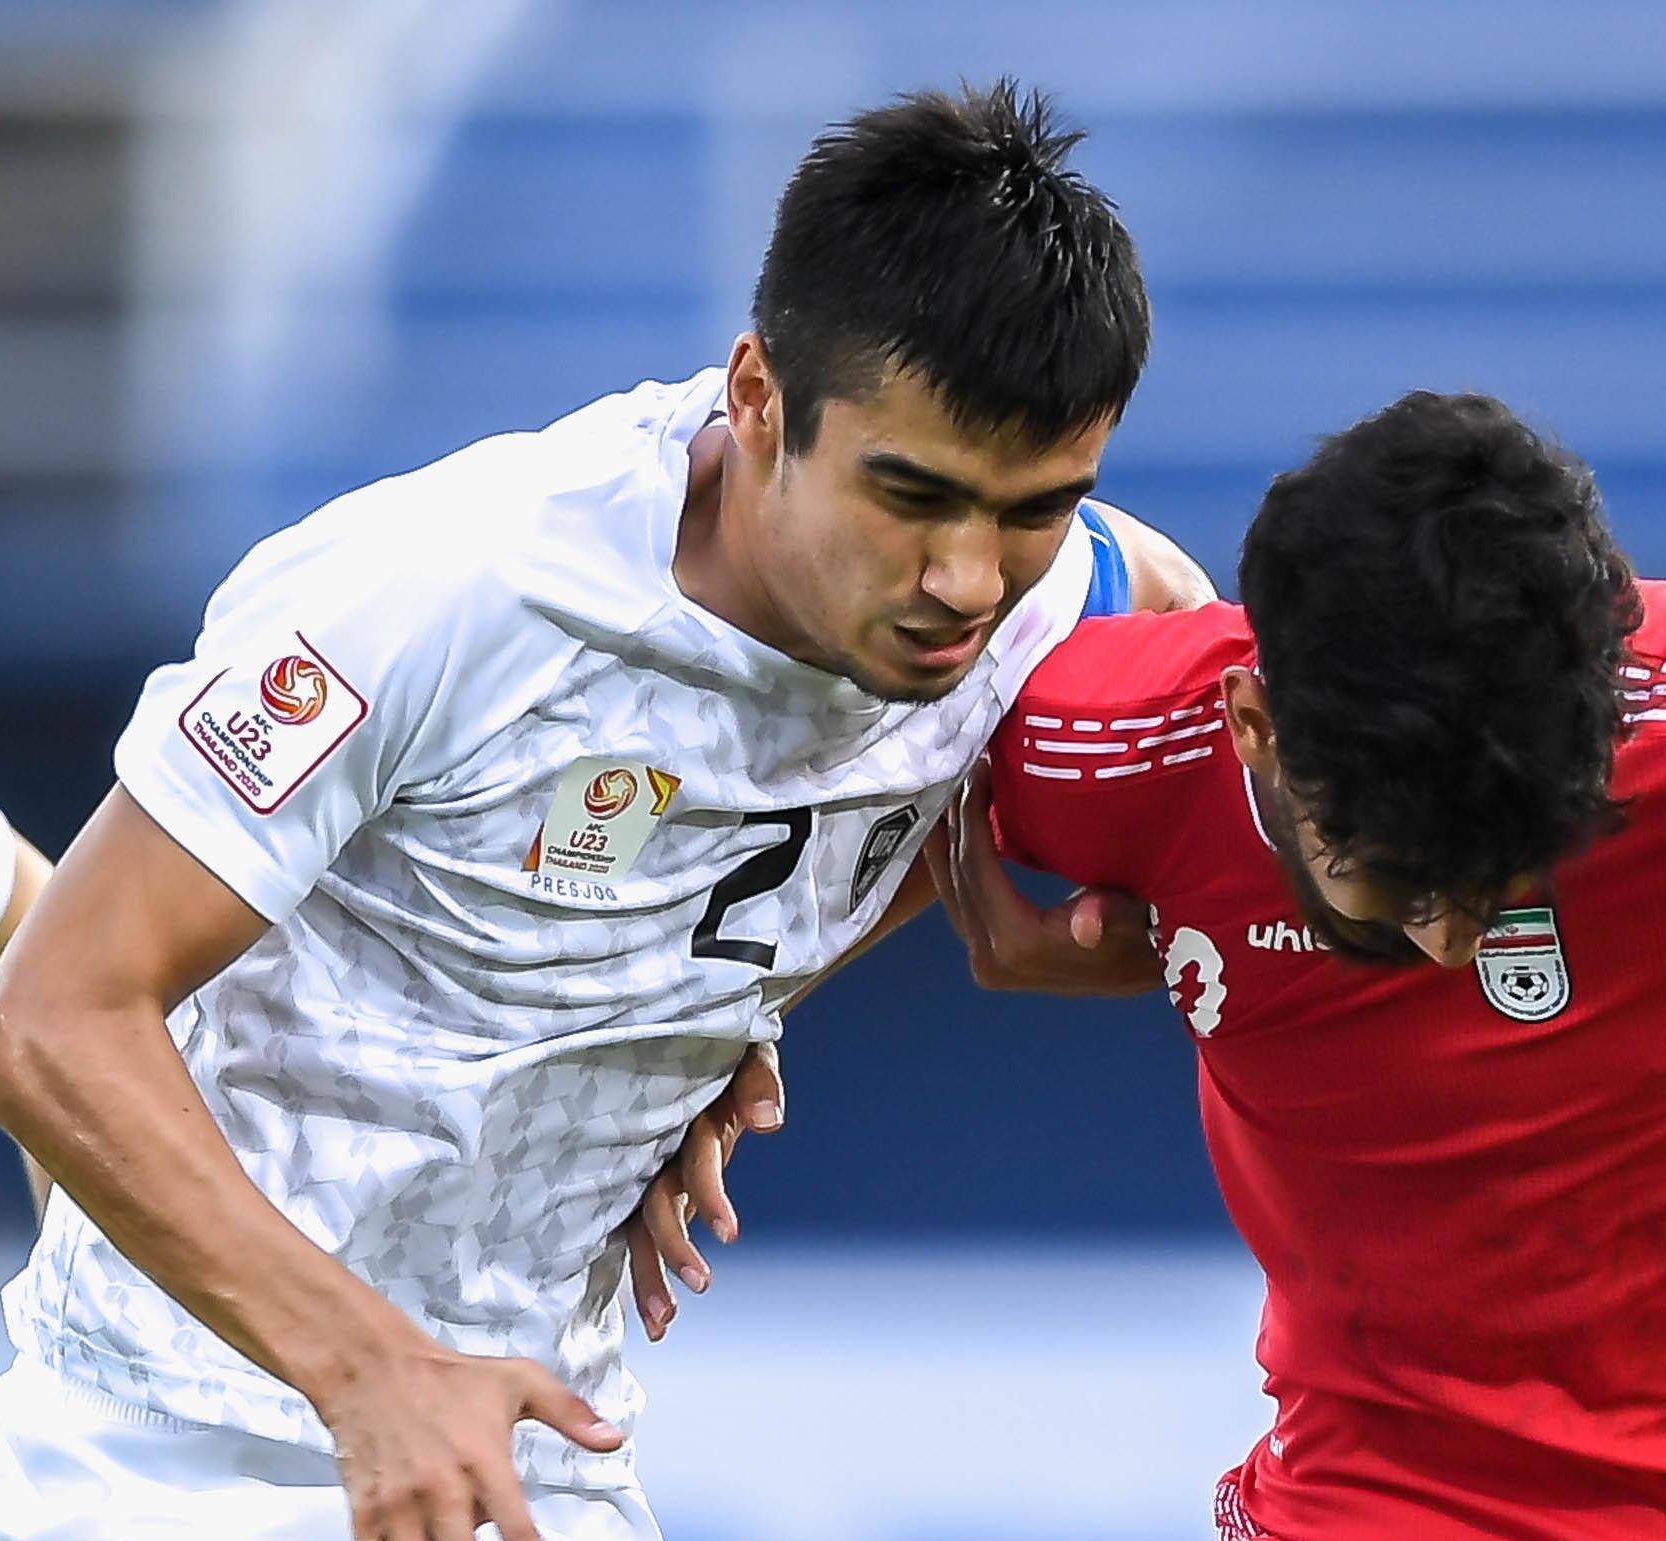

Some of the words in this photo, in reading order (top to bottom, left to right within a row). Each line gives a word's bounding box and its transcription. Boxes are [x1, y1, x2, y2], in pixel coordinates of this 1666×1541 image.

[201, 711, 273, 788] CHAMPIONSHIP
[226, 711, 272, 761] U23
[251, 713, 273, 735] AFC
[194, 720, 238, 772] THAILAND
[235, 769, 262, 797] 2020
[569, 830, 608, 852] U23
[691, 805, 813, 971] 2
